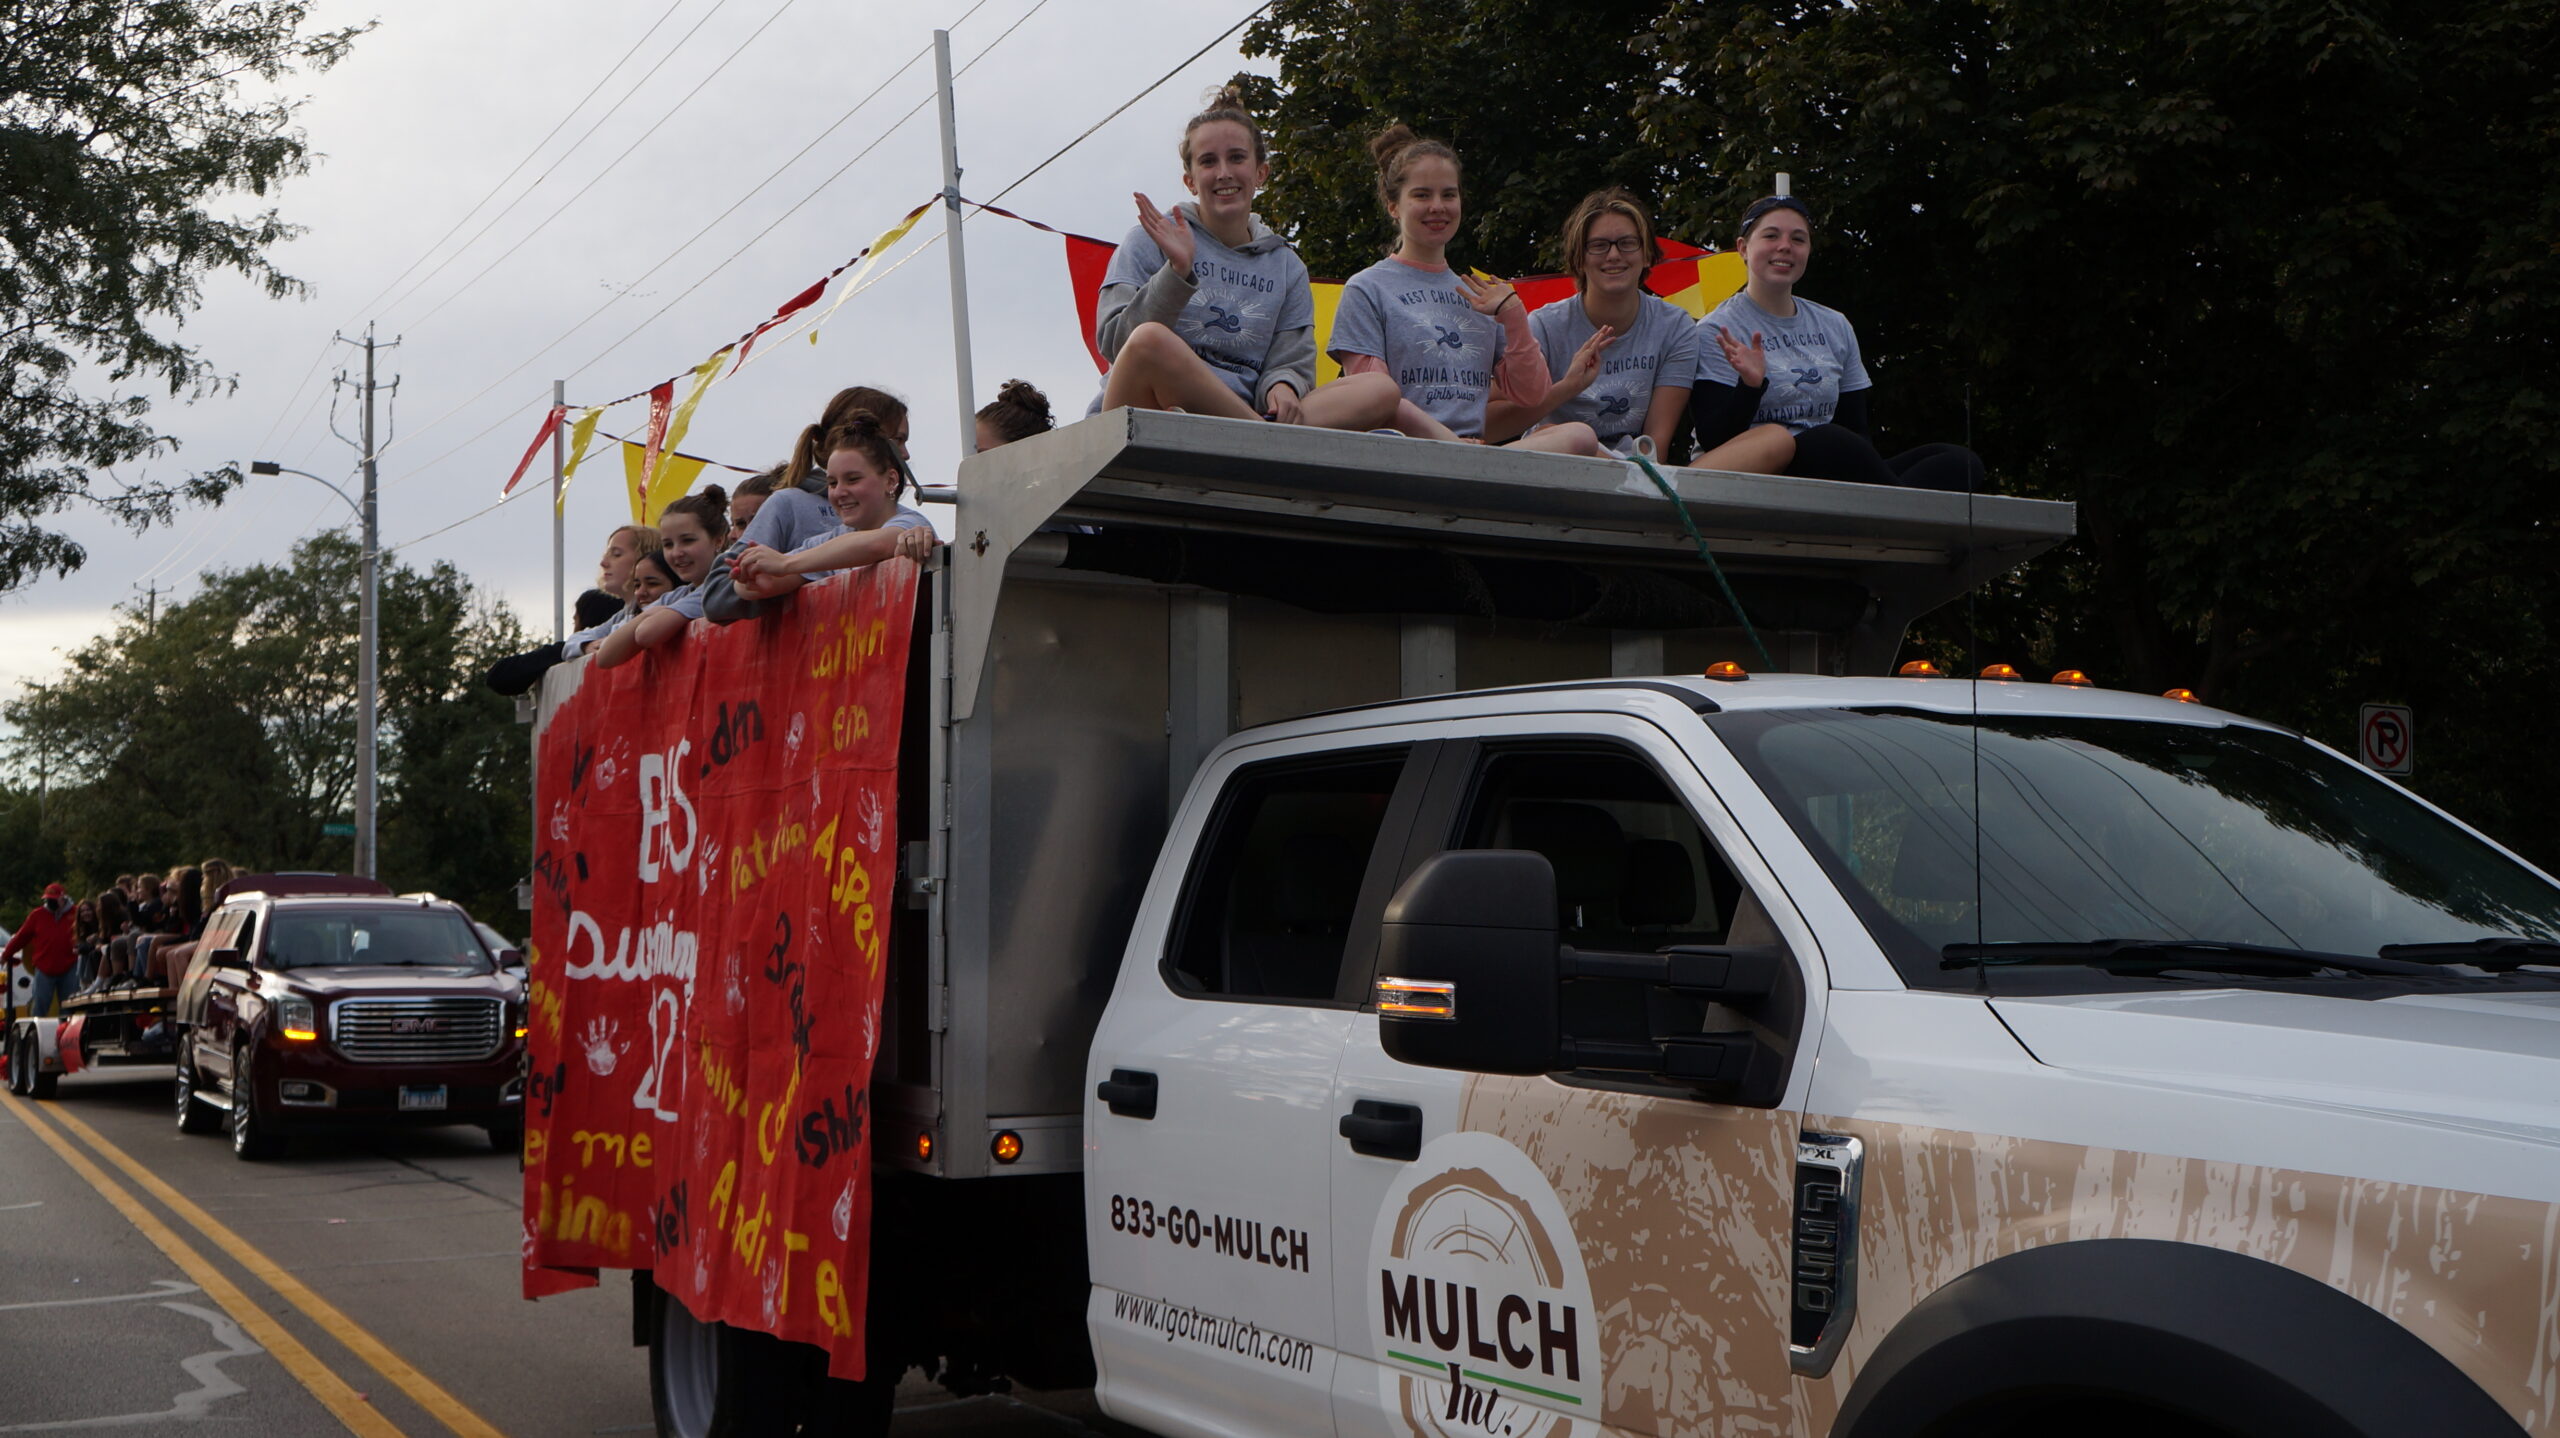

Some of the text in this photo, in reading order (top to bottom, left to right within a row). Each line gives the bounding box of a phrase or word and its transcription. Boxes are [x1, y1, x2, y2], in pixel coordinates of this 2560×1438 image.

[1194, 261, 1274, 293] EST CHICAGO
[1397, 289, 1471, 309] WEST CHICAG
[1763, 332, 1826, 352] EST CHICAGO
[1606, 355, 1655, 375] CHICAGO
[1401, 367, 1448, 385] BATAVIA
[1461, 370, 1492, 387] GENEV
[1426, 387, 1454, 405] girls
[1758, 406, 1805, 421] BATAVIA
[391, 1016, 449, 1034] GMC
[1815, 1148, 1835, 1160] XL
[1111, 1194, 1310, 1274] 833-GO-MULCH
[1115, 1292, 1314, 1374] www.igotmulch.com
[1381, 1268, 1580, 1383] MULCH
